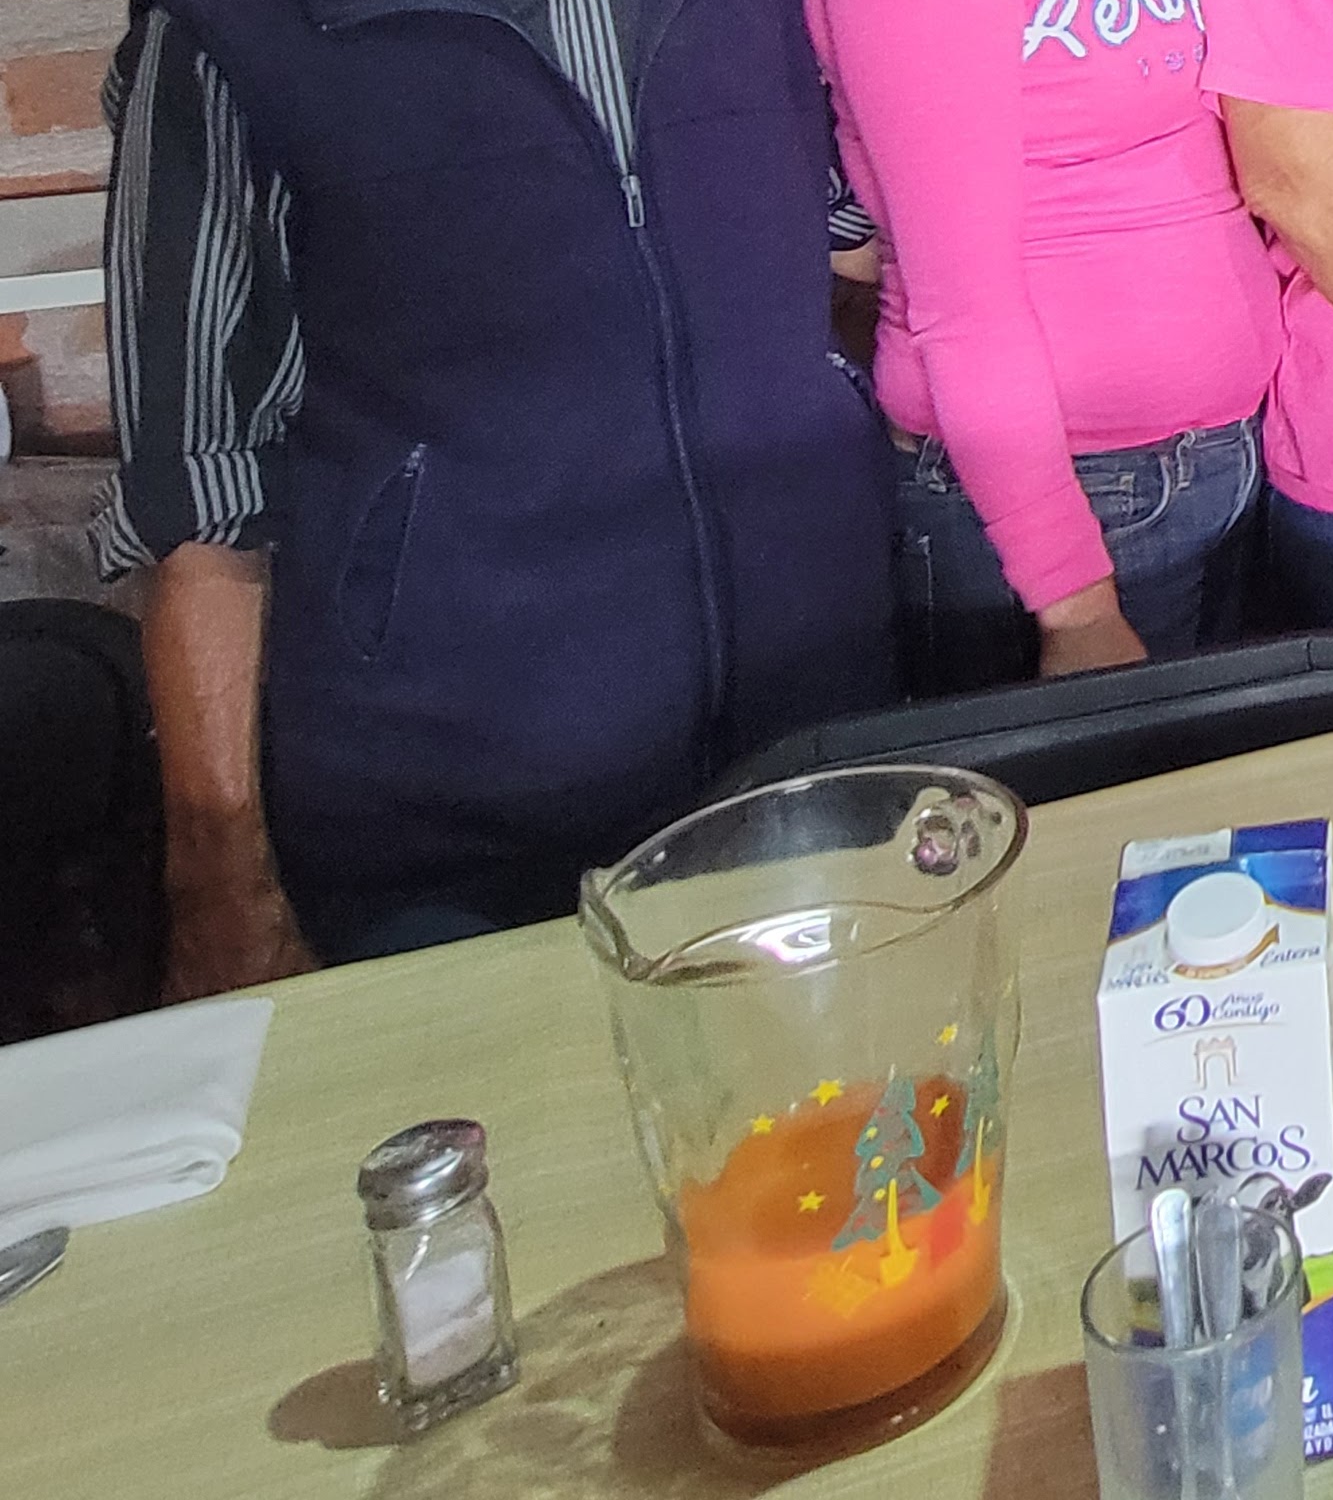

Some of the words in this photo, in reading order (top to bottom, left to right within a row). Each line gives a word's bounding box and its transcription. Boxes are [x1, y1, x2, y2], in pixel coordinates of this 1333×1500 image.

[1154, 994, 1211, 1032] 60
[1177, 1095, 1263, 1144] SAN
[1135, 1125, 1312, 1190] MARCOS
